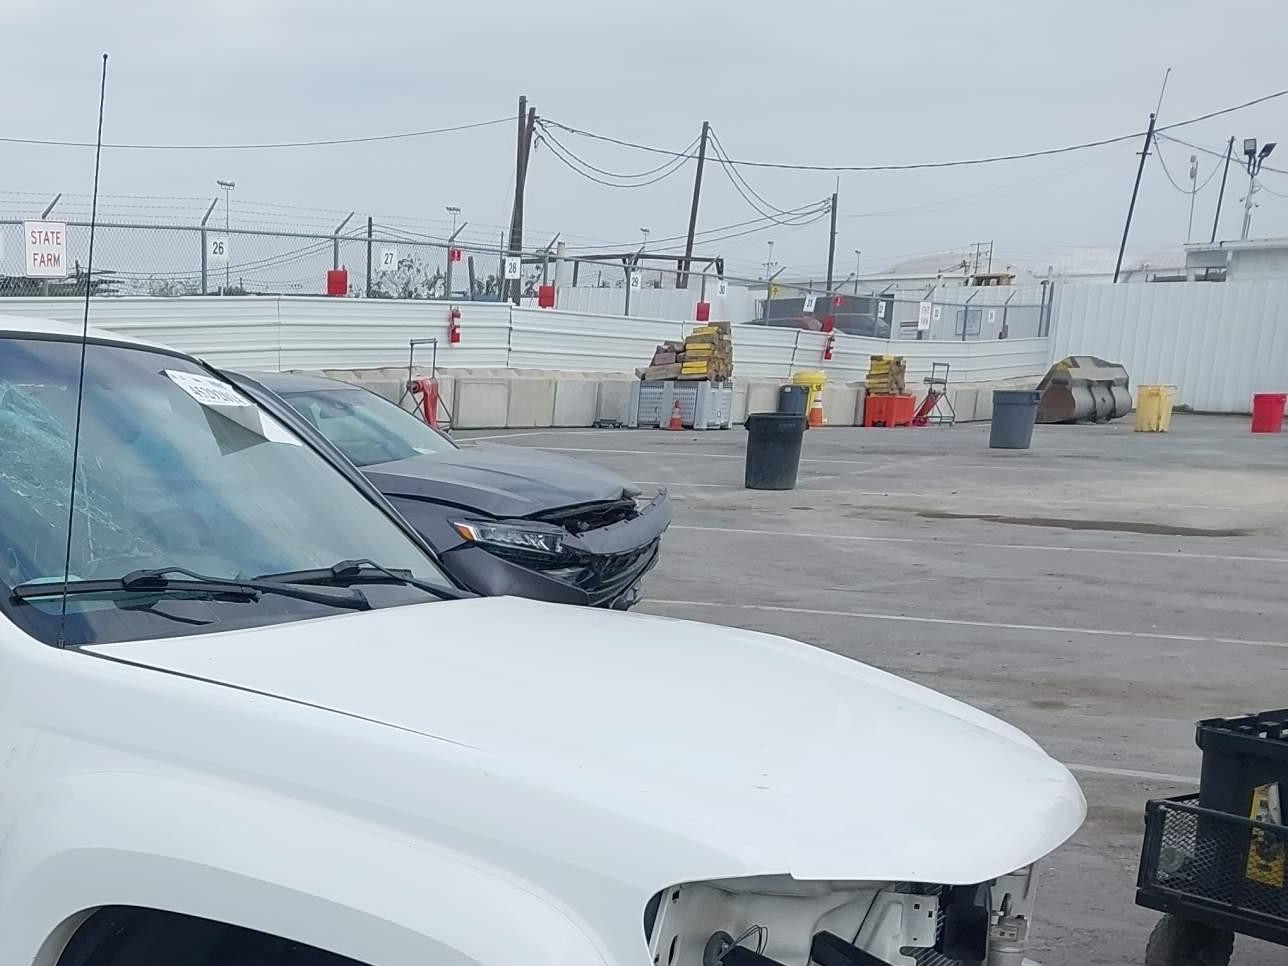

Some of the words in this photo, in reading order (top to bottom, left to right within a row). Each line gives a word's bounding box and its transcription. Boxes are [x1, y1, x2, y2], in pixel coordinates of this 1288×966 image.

[30, 230, 62, 246] STATE
[211, 240, 225, 256] 26
[32, 252, 61, 268] FARM
[383, 252, 394, 265] 27
[508, 262, 517, 274] 28
[631, 276, 639, 288] 29
